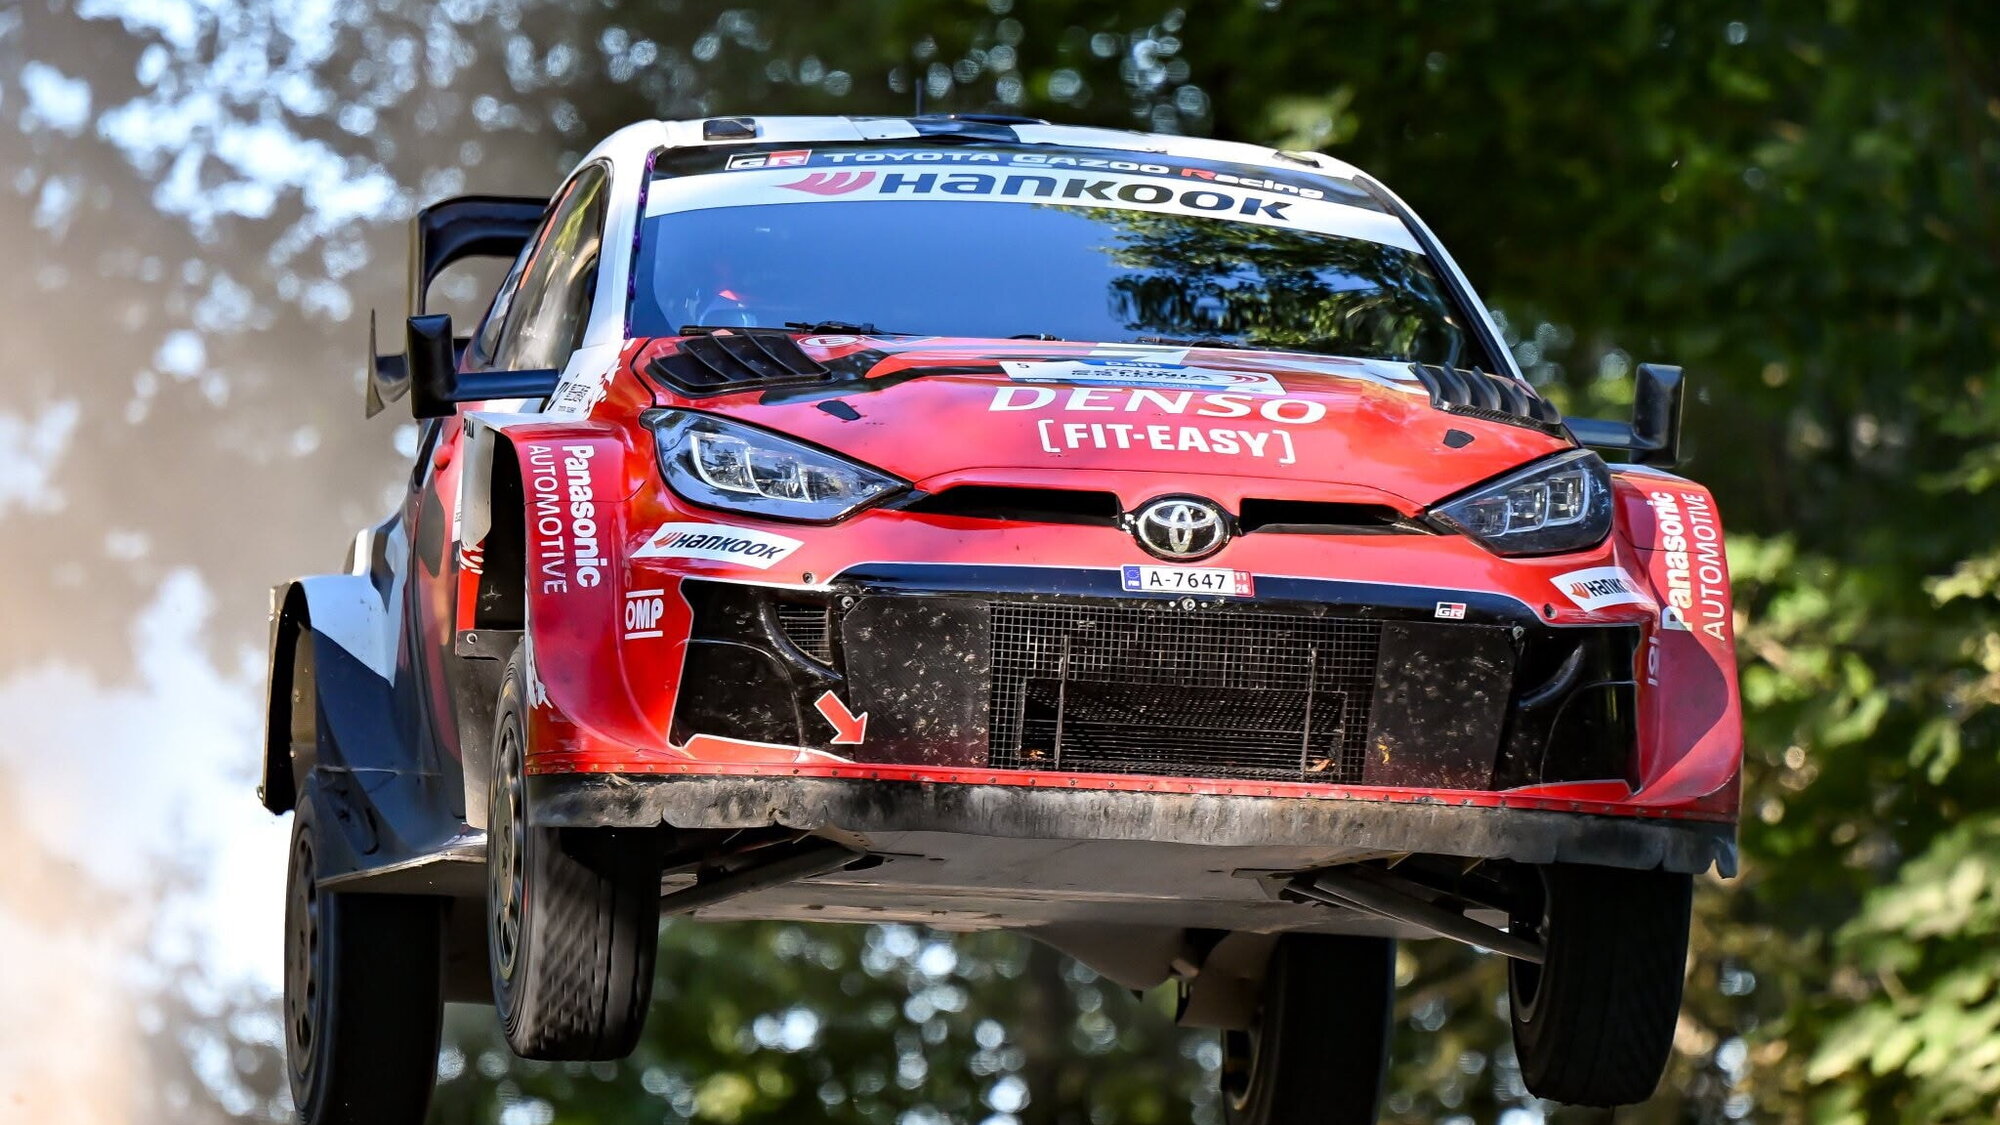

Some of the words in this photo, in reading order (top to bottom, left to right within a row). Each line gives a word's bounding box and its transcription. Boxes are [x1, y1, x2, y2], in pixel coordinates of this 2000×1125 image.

[730, 154, 806, 169] GR
[823, 153, 999, 162] TOYOTA
[1009, 153, 1170, 174] GAZOO
[1179, 168, 1324, 199] Racing
[988, 386, 1327, 424] DENSO
[528, 444, 568, 594] AUTOMOTIVE
[562, 445, 607, 588] Panasonic
[1150, 570, 1226, 590] A-7647
[1646, 491, 1693, 632] Panasonic
[1681, 492, 1726, 641] AUTOMOTIVE
[625, 598, 664, 630] OMP
[1437, 607, 1464, 618] GR
